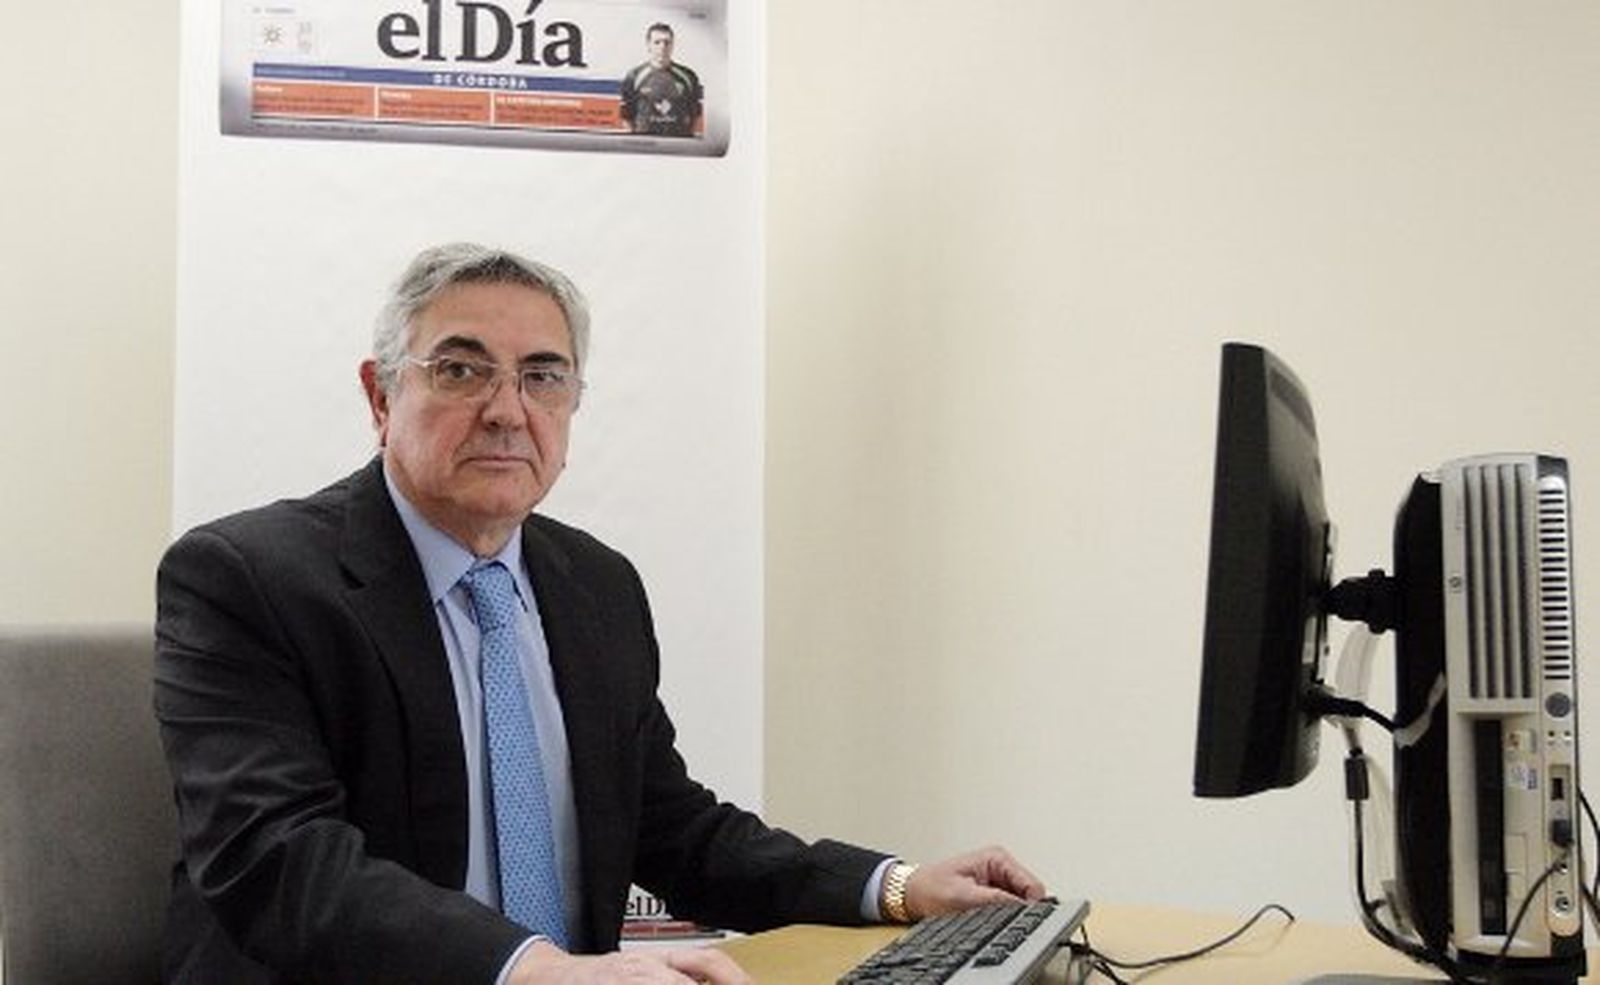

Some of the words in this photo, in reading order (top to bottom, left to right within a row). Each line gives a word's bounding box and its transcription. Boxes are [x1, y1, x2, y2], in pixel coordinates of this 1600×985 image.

[377, 0, 446, 61] el
[454, 0, 588, 68] Día
[433, 74, 452, 86] DE
